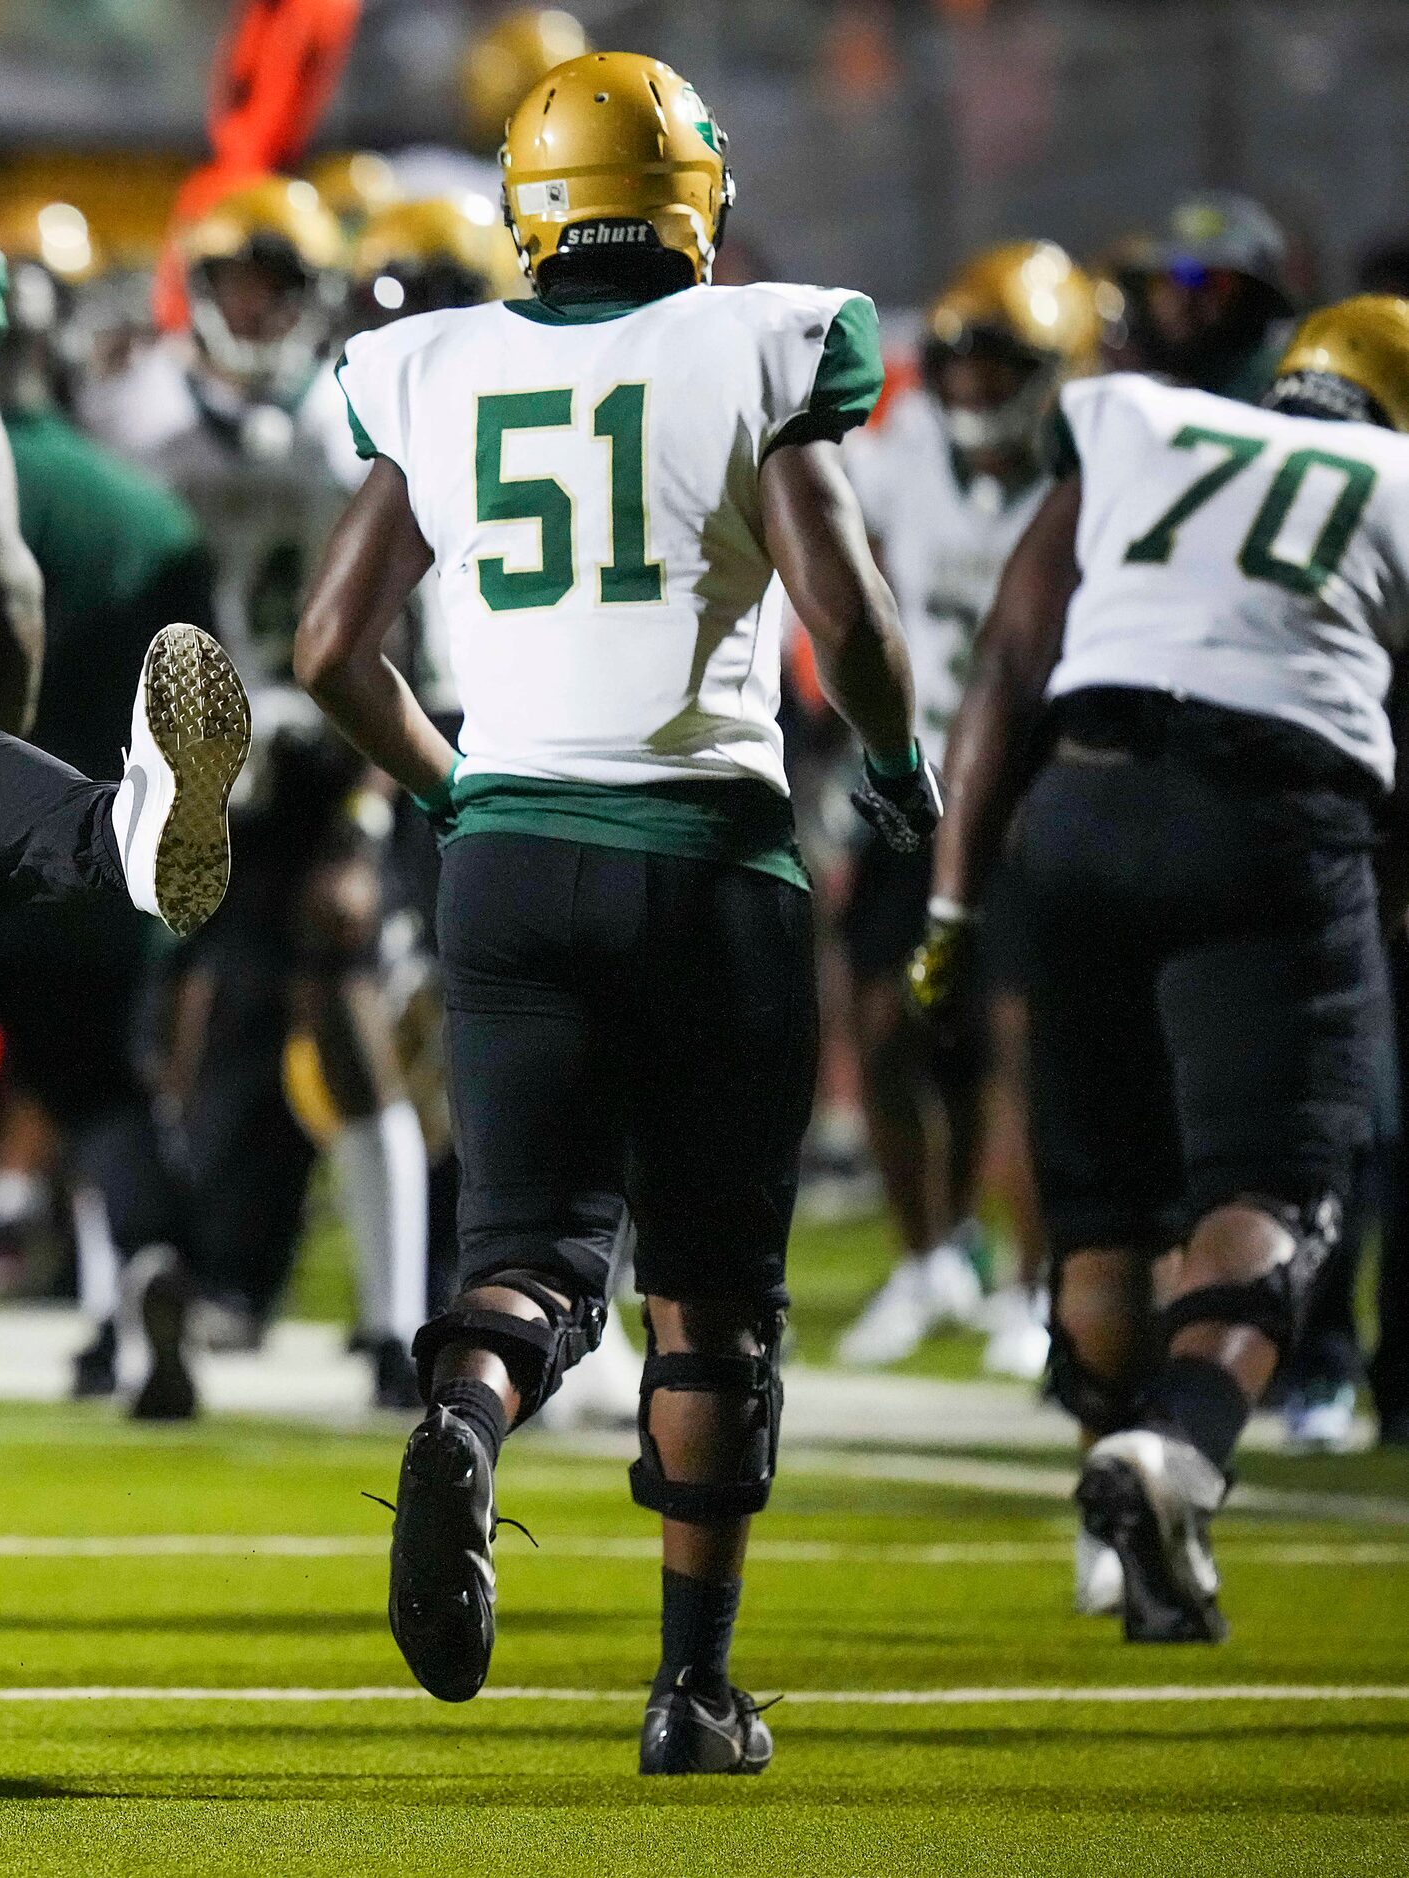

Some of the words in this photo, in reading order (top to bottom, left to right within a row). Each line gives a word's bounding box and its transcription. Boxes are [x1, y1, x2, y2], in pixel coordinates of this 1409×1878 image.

[567, 223, 648, 245] schutt
[473, 378, 668, 617] 51
[1120, 423, 1381, 596] 70
